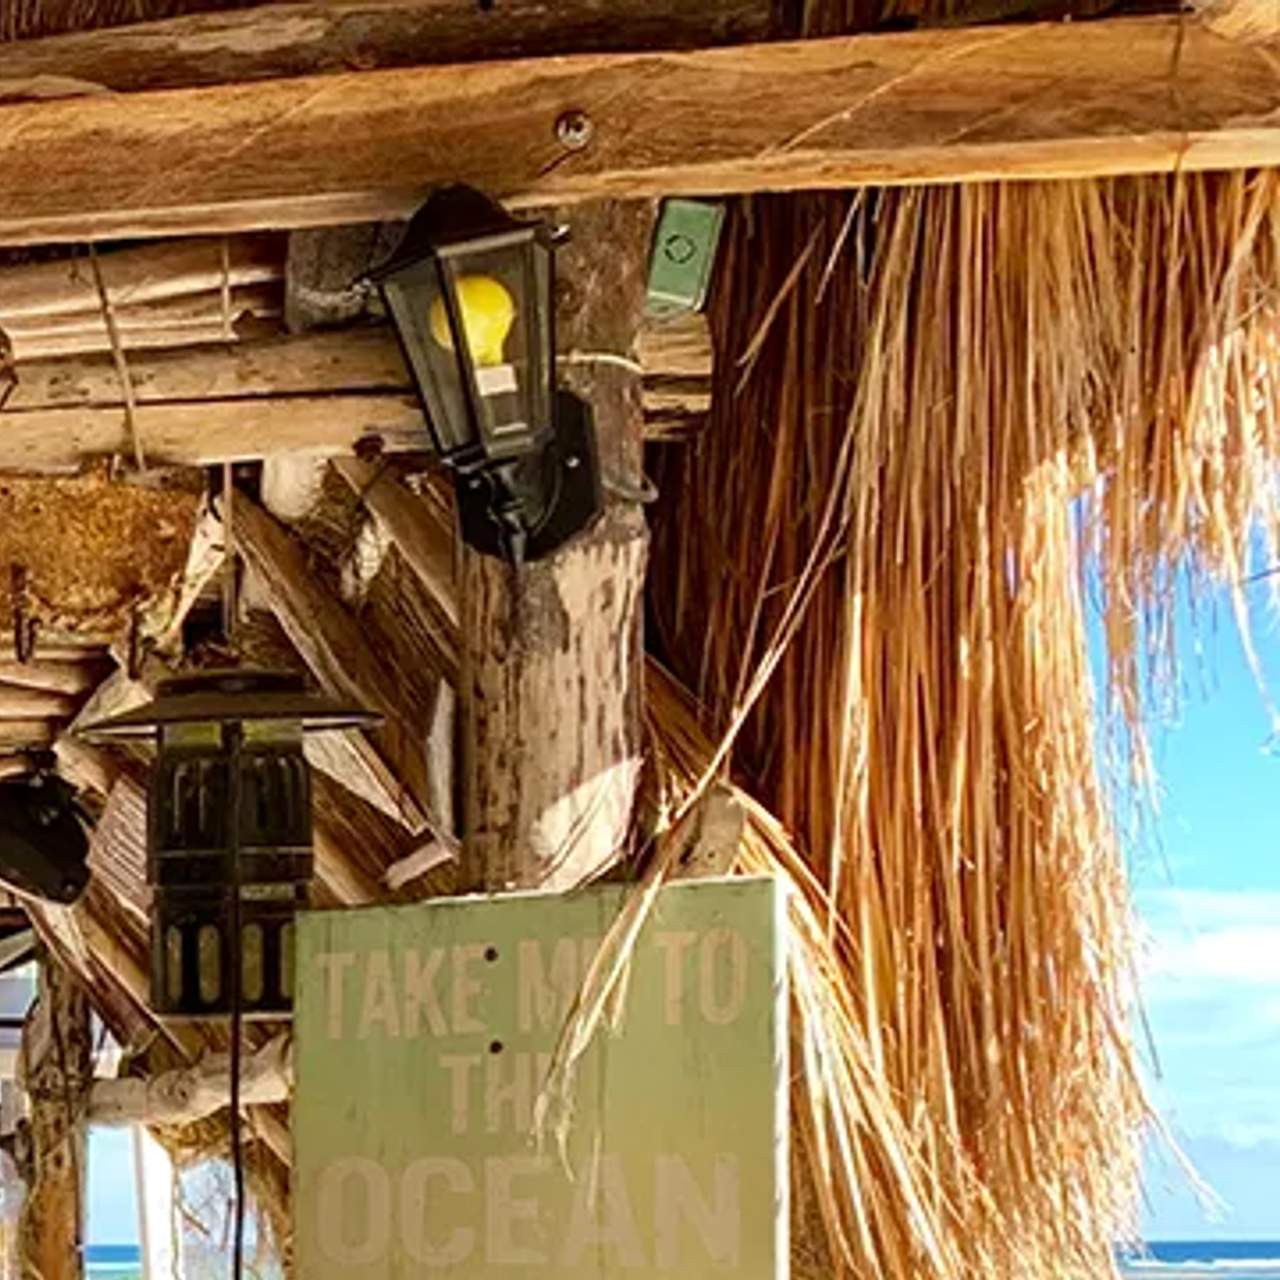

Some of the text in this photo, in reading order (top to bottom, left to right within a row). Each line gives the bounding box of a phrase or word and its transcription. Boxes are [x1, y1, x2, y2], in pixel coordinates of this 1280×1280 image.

[314, 943, 488, 1040] TAKE
[652, 928, 750, 1026] TO
[315, 1150, 741, 1268] OCEAN
